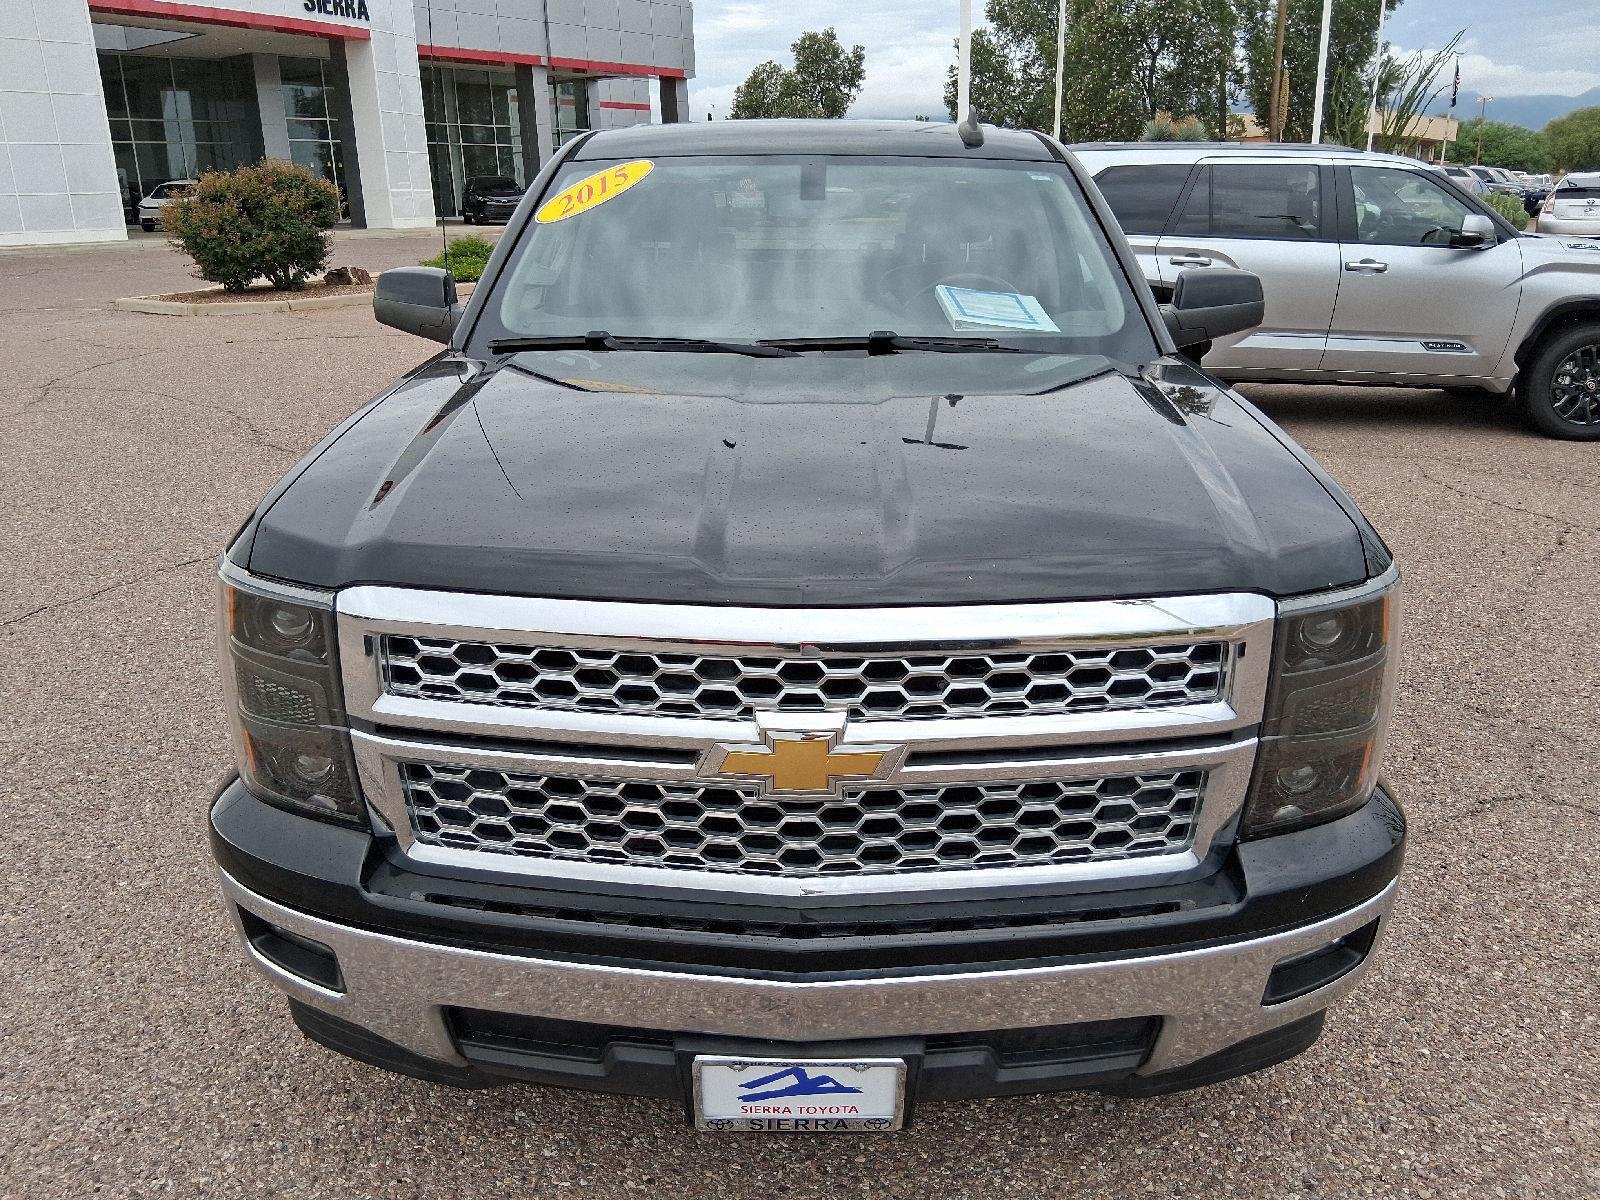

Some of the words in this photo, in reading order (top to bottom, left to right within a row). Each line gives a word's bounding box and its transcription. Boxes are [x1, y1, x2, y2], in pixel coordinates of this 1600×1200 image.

[303, 0, 370, 21] SIERRA
[559, 167, 629, 216] 2015
[740, 1105, 792, 1114] SIERRA
[797, 1105, 859, 1114] TOYOTA
[749, 1119, 849, 1131] SIERRA
